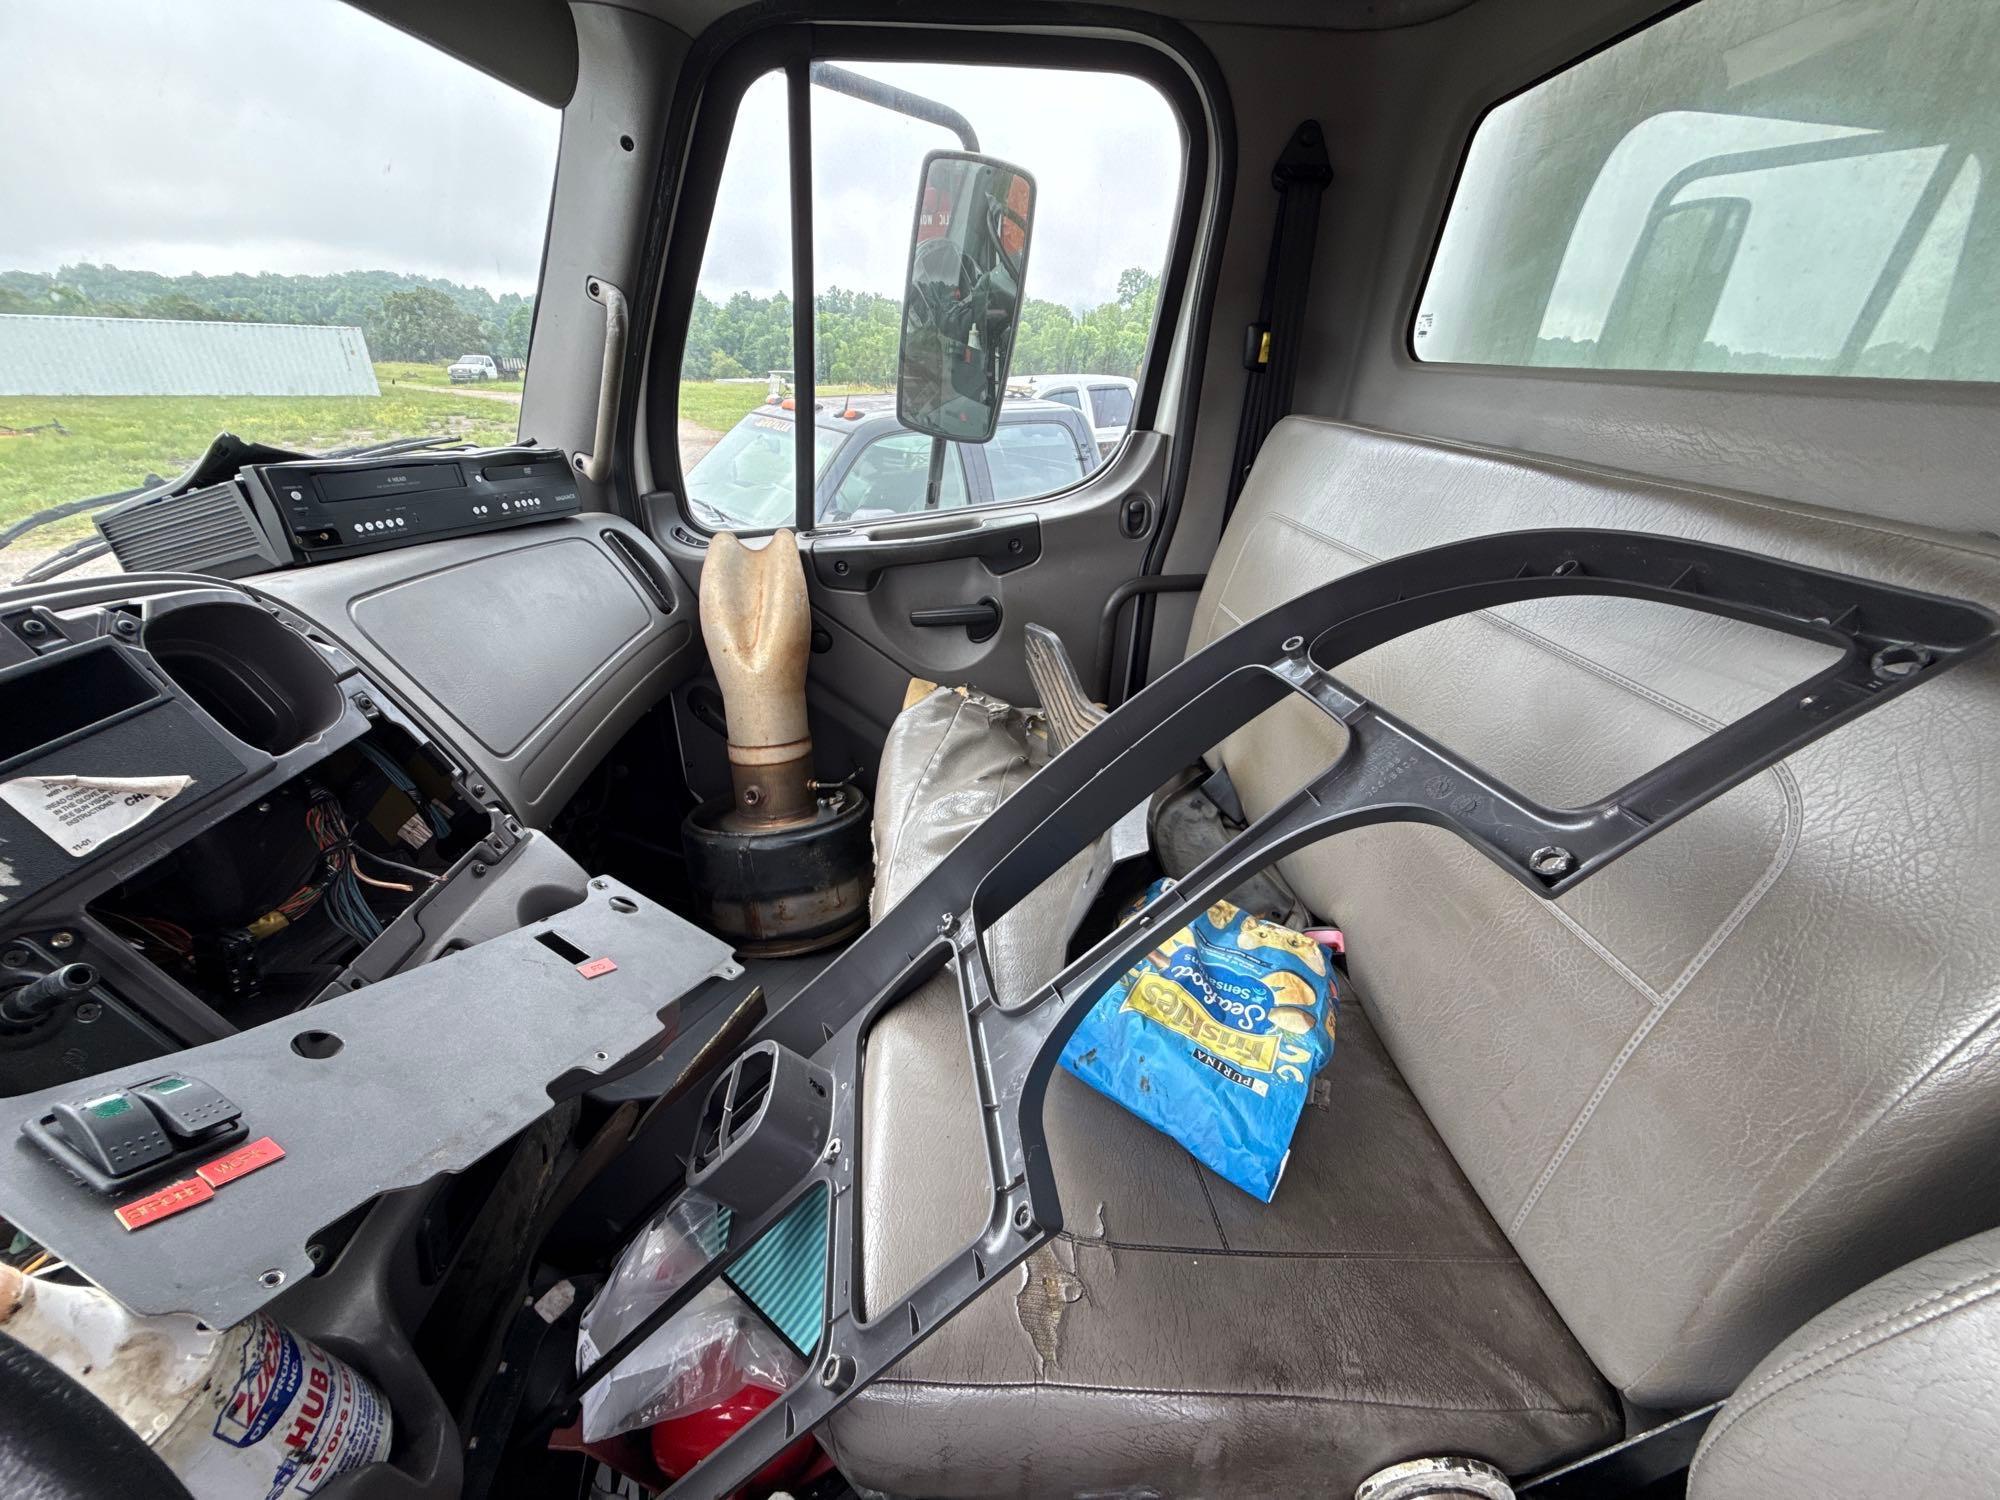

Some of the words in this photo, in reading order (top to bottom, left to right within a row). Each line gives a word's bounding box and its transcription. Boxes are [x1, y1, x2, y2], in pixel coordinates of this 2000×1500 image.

[60, 801, 77, 811] THE
[75, 790, 101, 804] GLOVE
[74, 803, 90, 814] SUN
[88, 794, 110, 806] VISOR
[72, 838, 92, 851] 11-01
[1144, 981, 1267, 1063] Friskies
[1170, 965, 1266, 1030] Seafood
[1197, 1050, 1253, 1086] PURINA
[284, 1367, 329, 1448] HUB
[309, 1408, 349, 1482] STOPS
